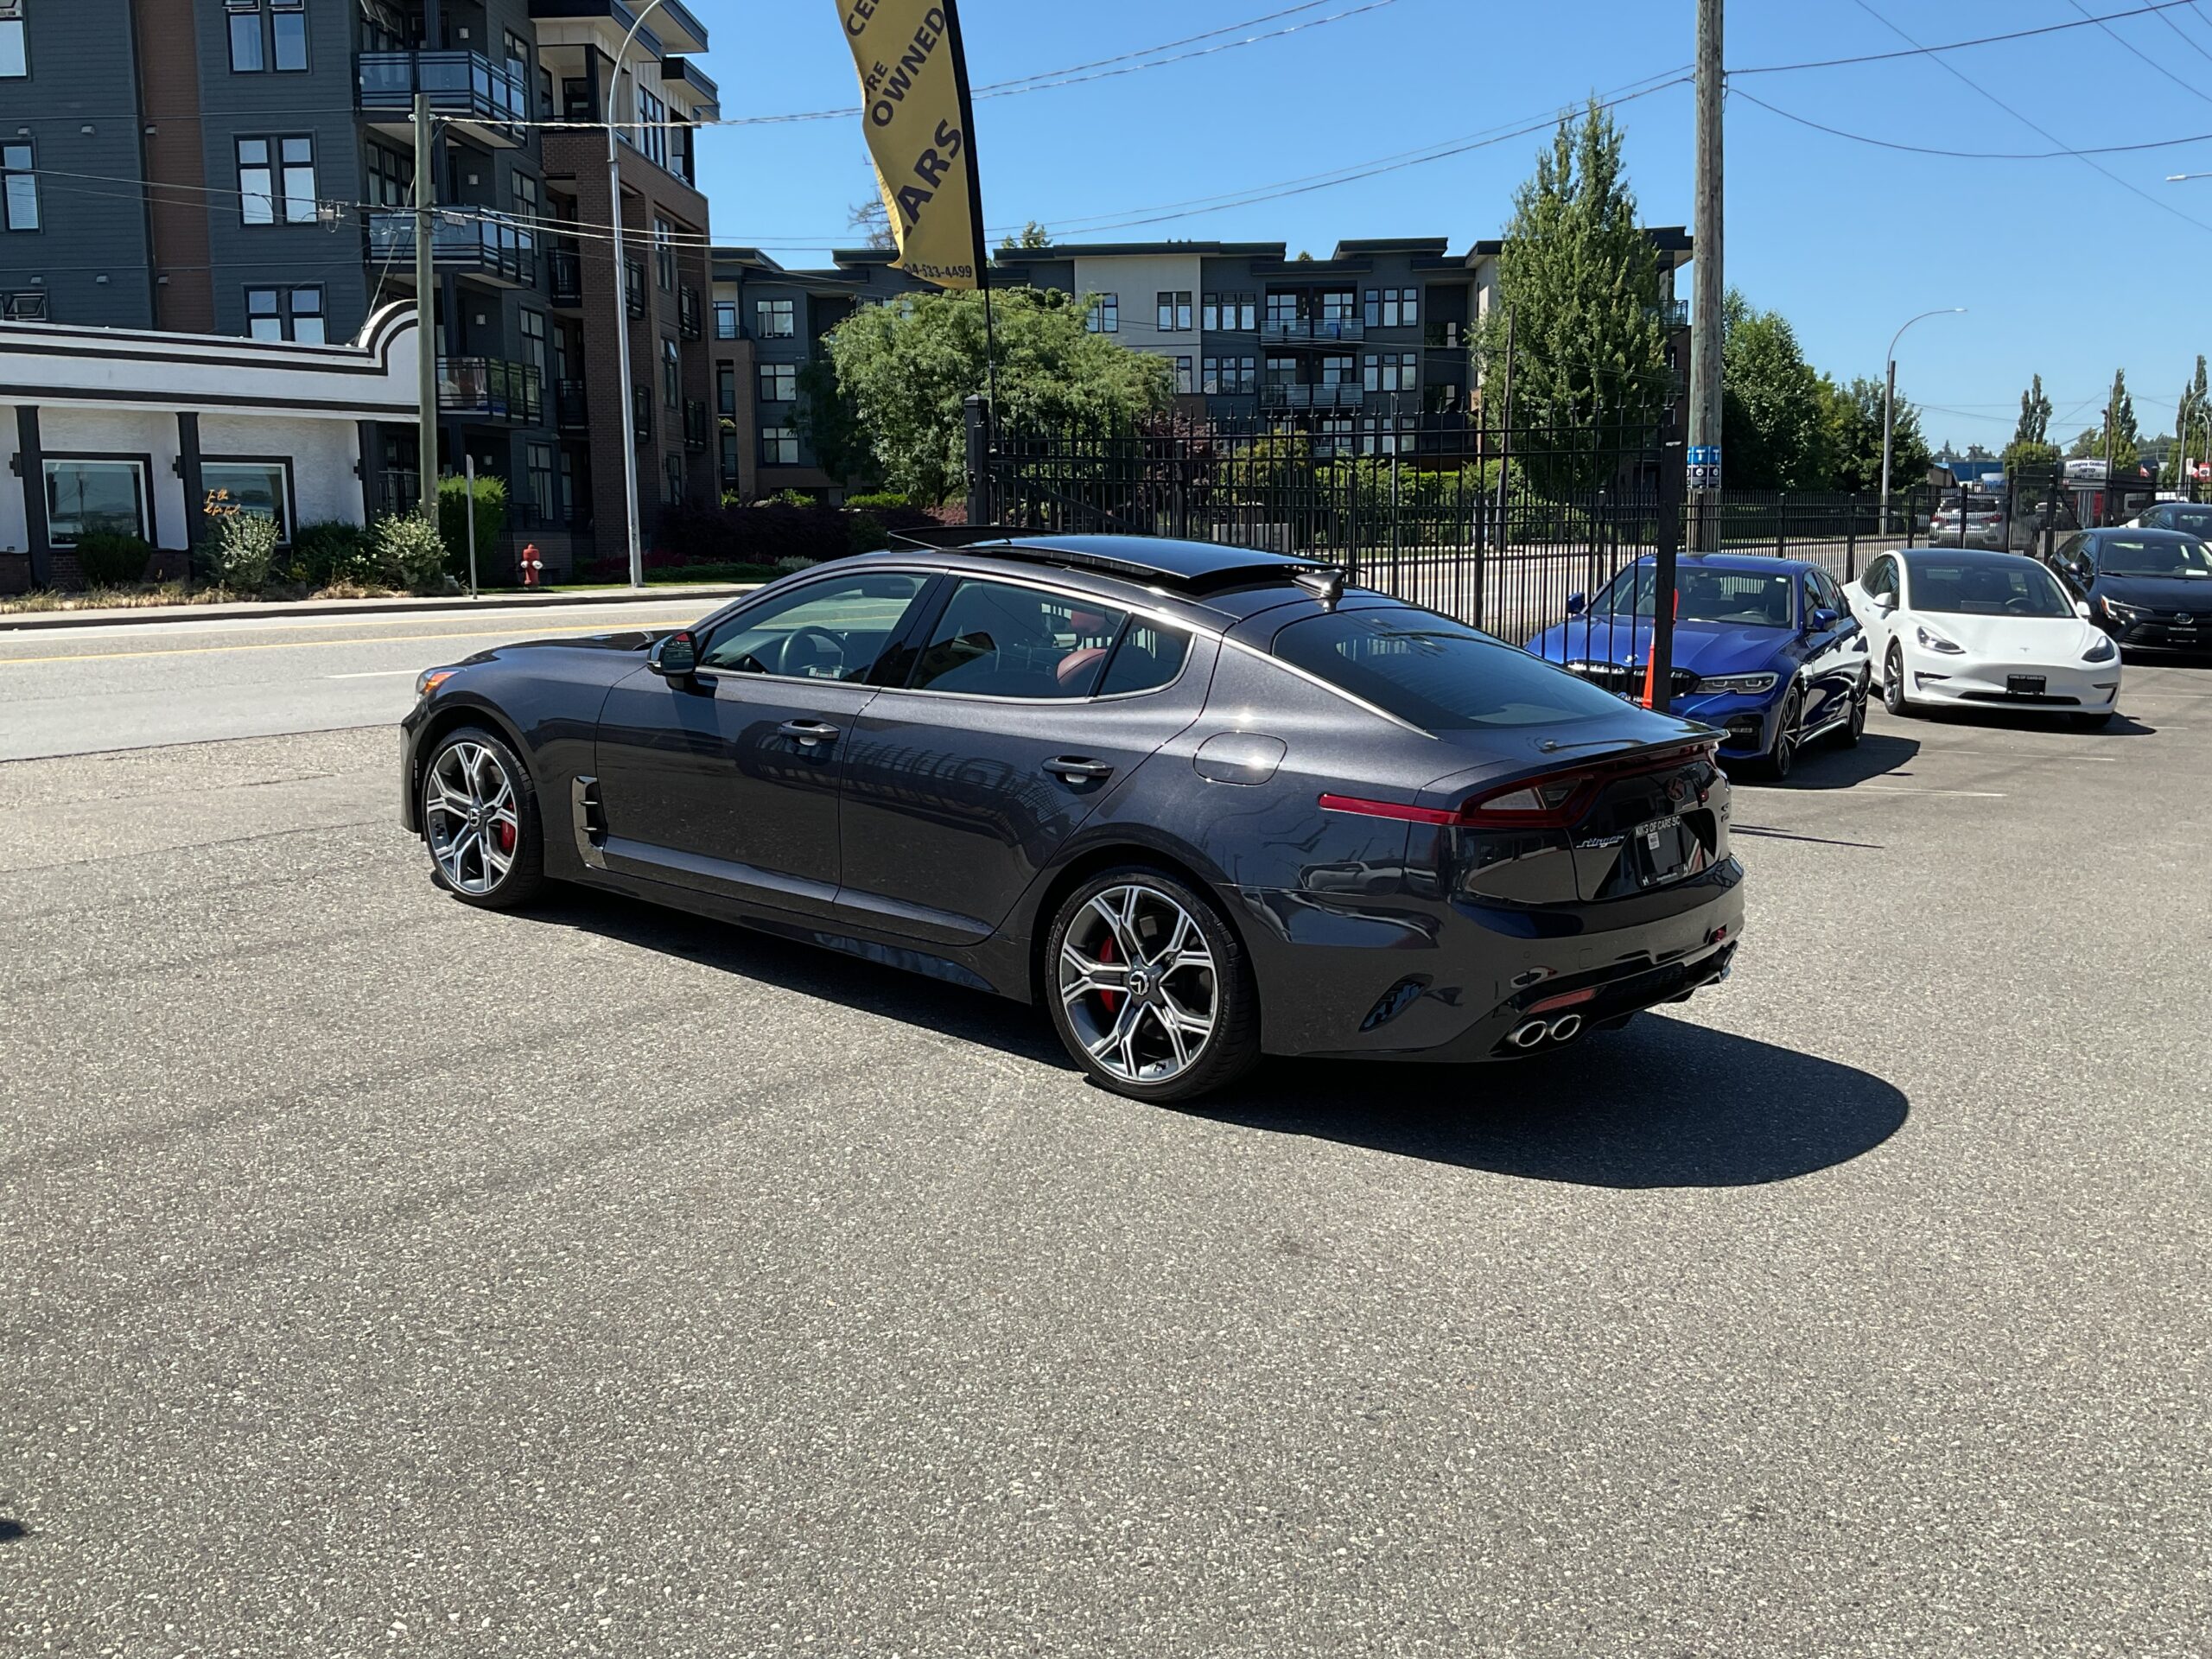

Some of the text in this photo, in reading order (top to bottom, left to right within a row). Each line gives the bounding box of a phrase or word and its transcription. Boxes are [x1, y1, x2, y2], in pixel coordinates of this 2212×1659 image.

[847, 0, 880, 36] CE
[872, 7, 946, 127] OWNED
[897, 118, 962, 240] ARS
[1635, 823, 1649, 837] KING
[1649, 820, 1658, 833] OF
[1658, 817, 1672, 830] CARS
